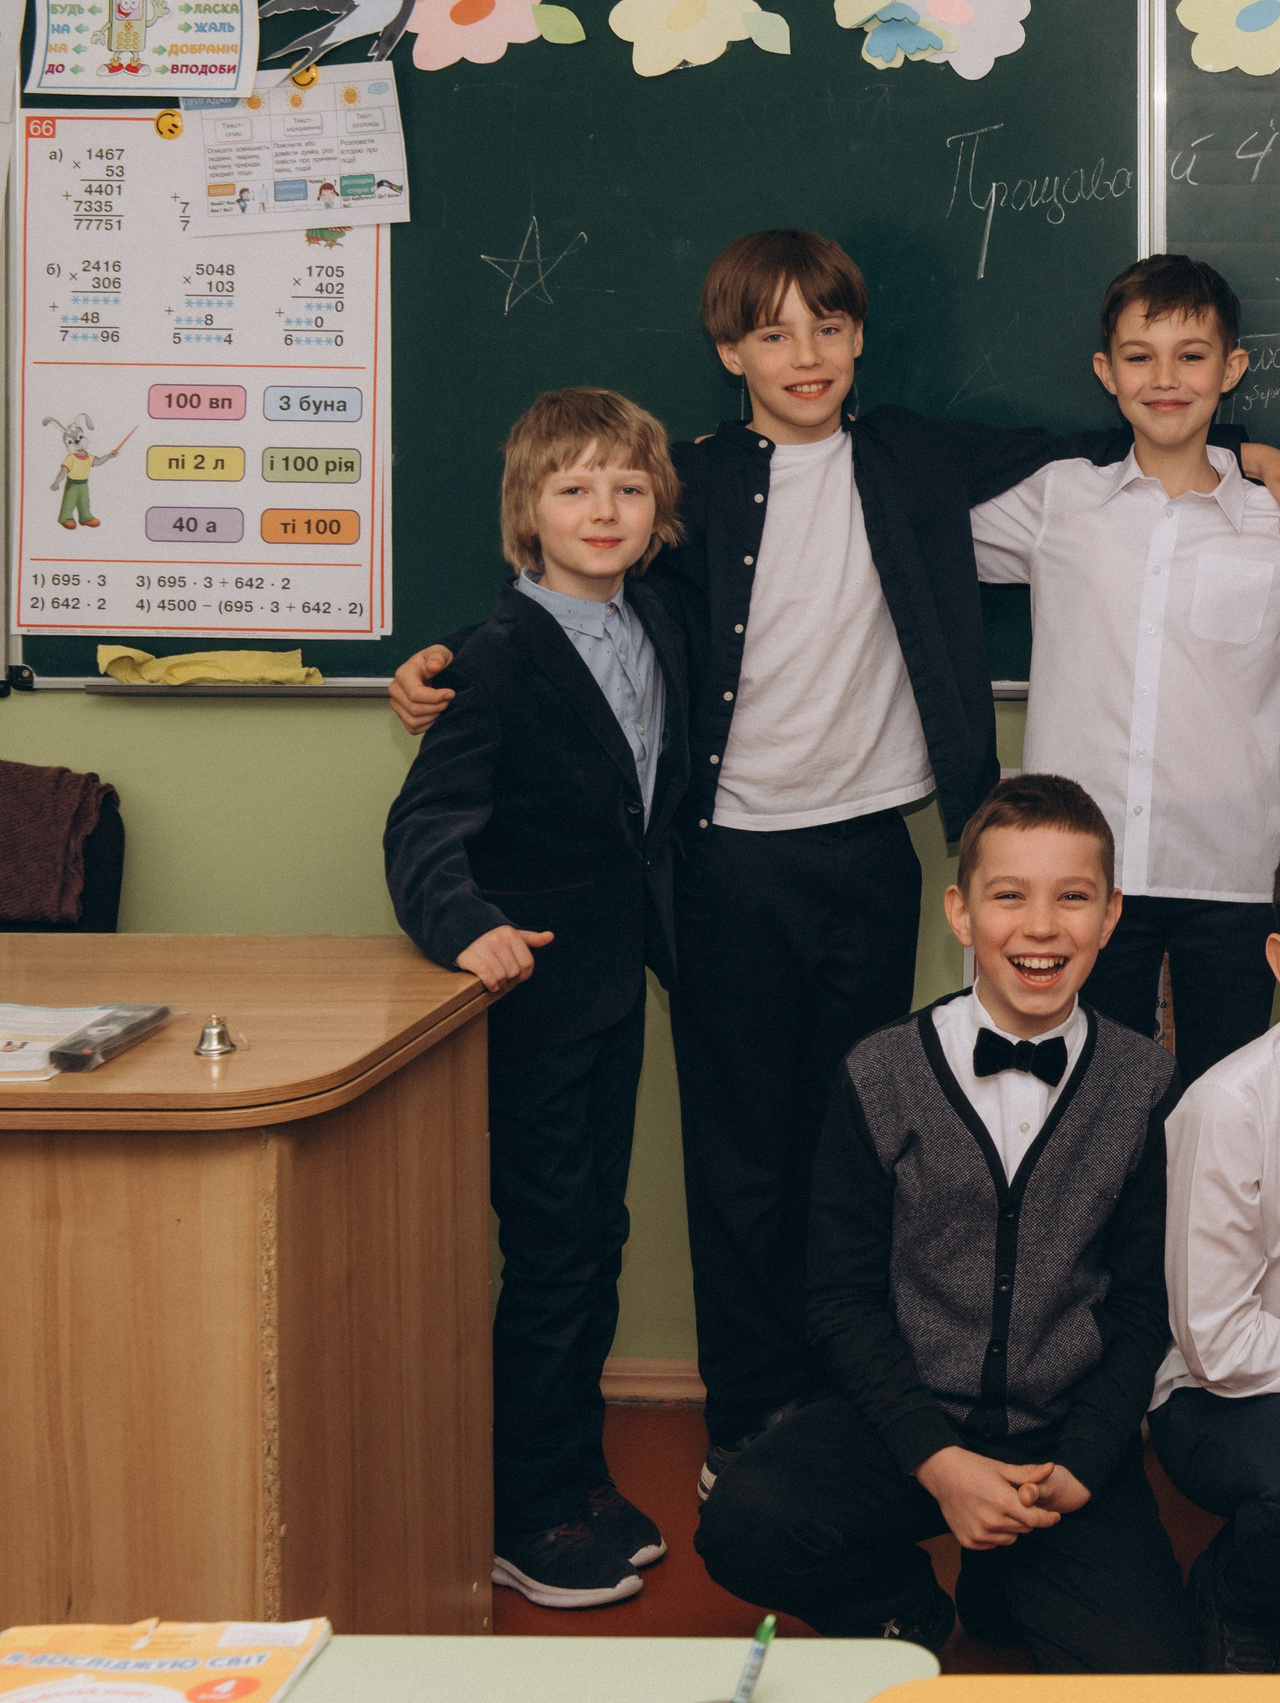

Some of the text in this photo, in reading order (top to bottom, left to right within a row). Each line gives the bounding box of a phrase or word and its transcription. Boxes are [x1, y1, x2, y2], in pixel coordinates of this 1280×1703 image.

[50, 4, 85, 16] БУДЬ
[193, 3, 239, 14] ЛАСКА
[51, 24, 71, 34] НА
[194, 22, 235, 33] ЖАЛЬ
[49, 43, 68, 53] НА
[167, 44, 238, 57] ДОБРАНІЧ
[45, 64, 65, 75] ДО
[170, 64, 237, 75] ВПОДОБИ
[29, 120, 54, 136] 66
[49, 149, 63, 163] а)
[86, 149, 125, 160] 1467
[105, 166, 125, 177] 53
[84, 184, 122, 196] 4401
[73, 201, 113, 212] 7335
[74, 219, 122, 231] 77751
[46, 263, 61, 278] б)
[82, 260, 121, 272] 2416
[195, 264, 235, 276] 5048
[307, 265, 344, 278] 1705
[92, 277, 121, 289] 306
[207, 281, 234, 293] 103
[315, 282, 344, 294] 402
[165, 393, 233, 409] 100 вп
[299, 395, 347, 415] буна
[168, 455, 225, 470] пі 2 л
[282, 456, 319, 472] 100
[325, 458, 355, 475] рія
[172, 517, 217, 533] 40 а
[281, 519, 341, 534] ті 100
[32, 573, 107, 588] 1) 695 3
[136, 576, 151, 590] 3)
[157, 576, 187, 588] 695
[203, 577, 213, 589] 3
[235, 577, 264, 589] 642
[281, 578, 291, 590] 2
[30, 597, 106, 611] 2) 642 2
[136, 599, 151, 613] 4)
[157, 599, 197, 611] 4500
[218, 601, 253, 615] (695
[270, 601, 280, 613] 3
[302, 602, 331, 614] 642
[348, 602, 364, 617] 2)
